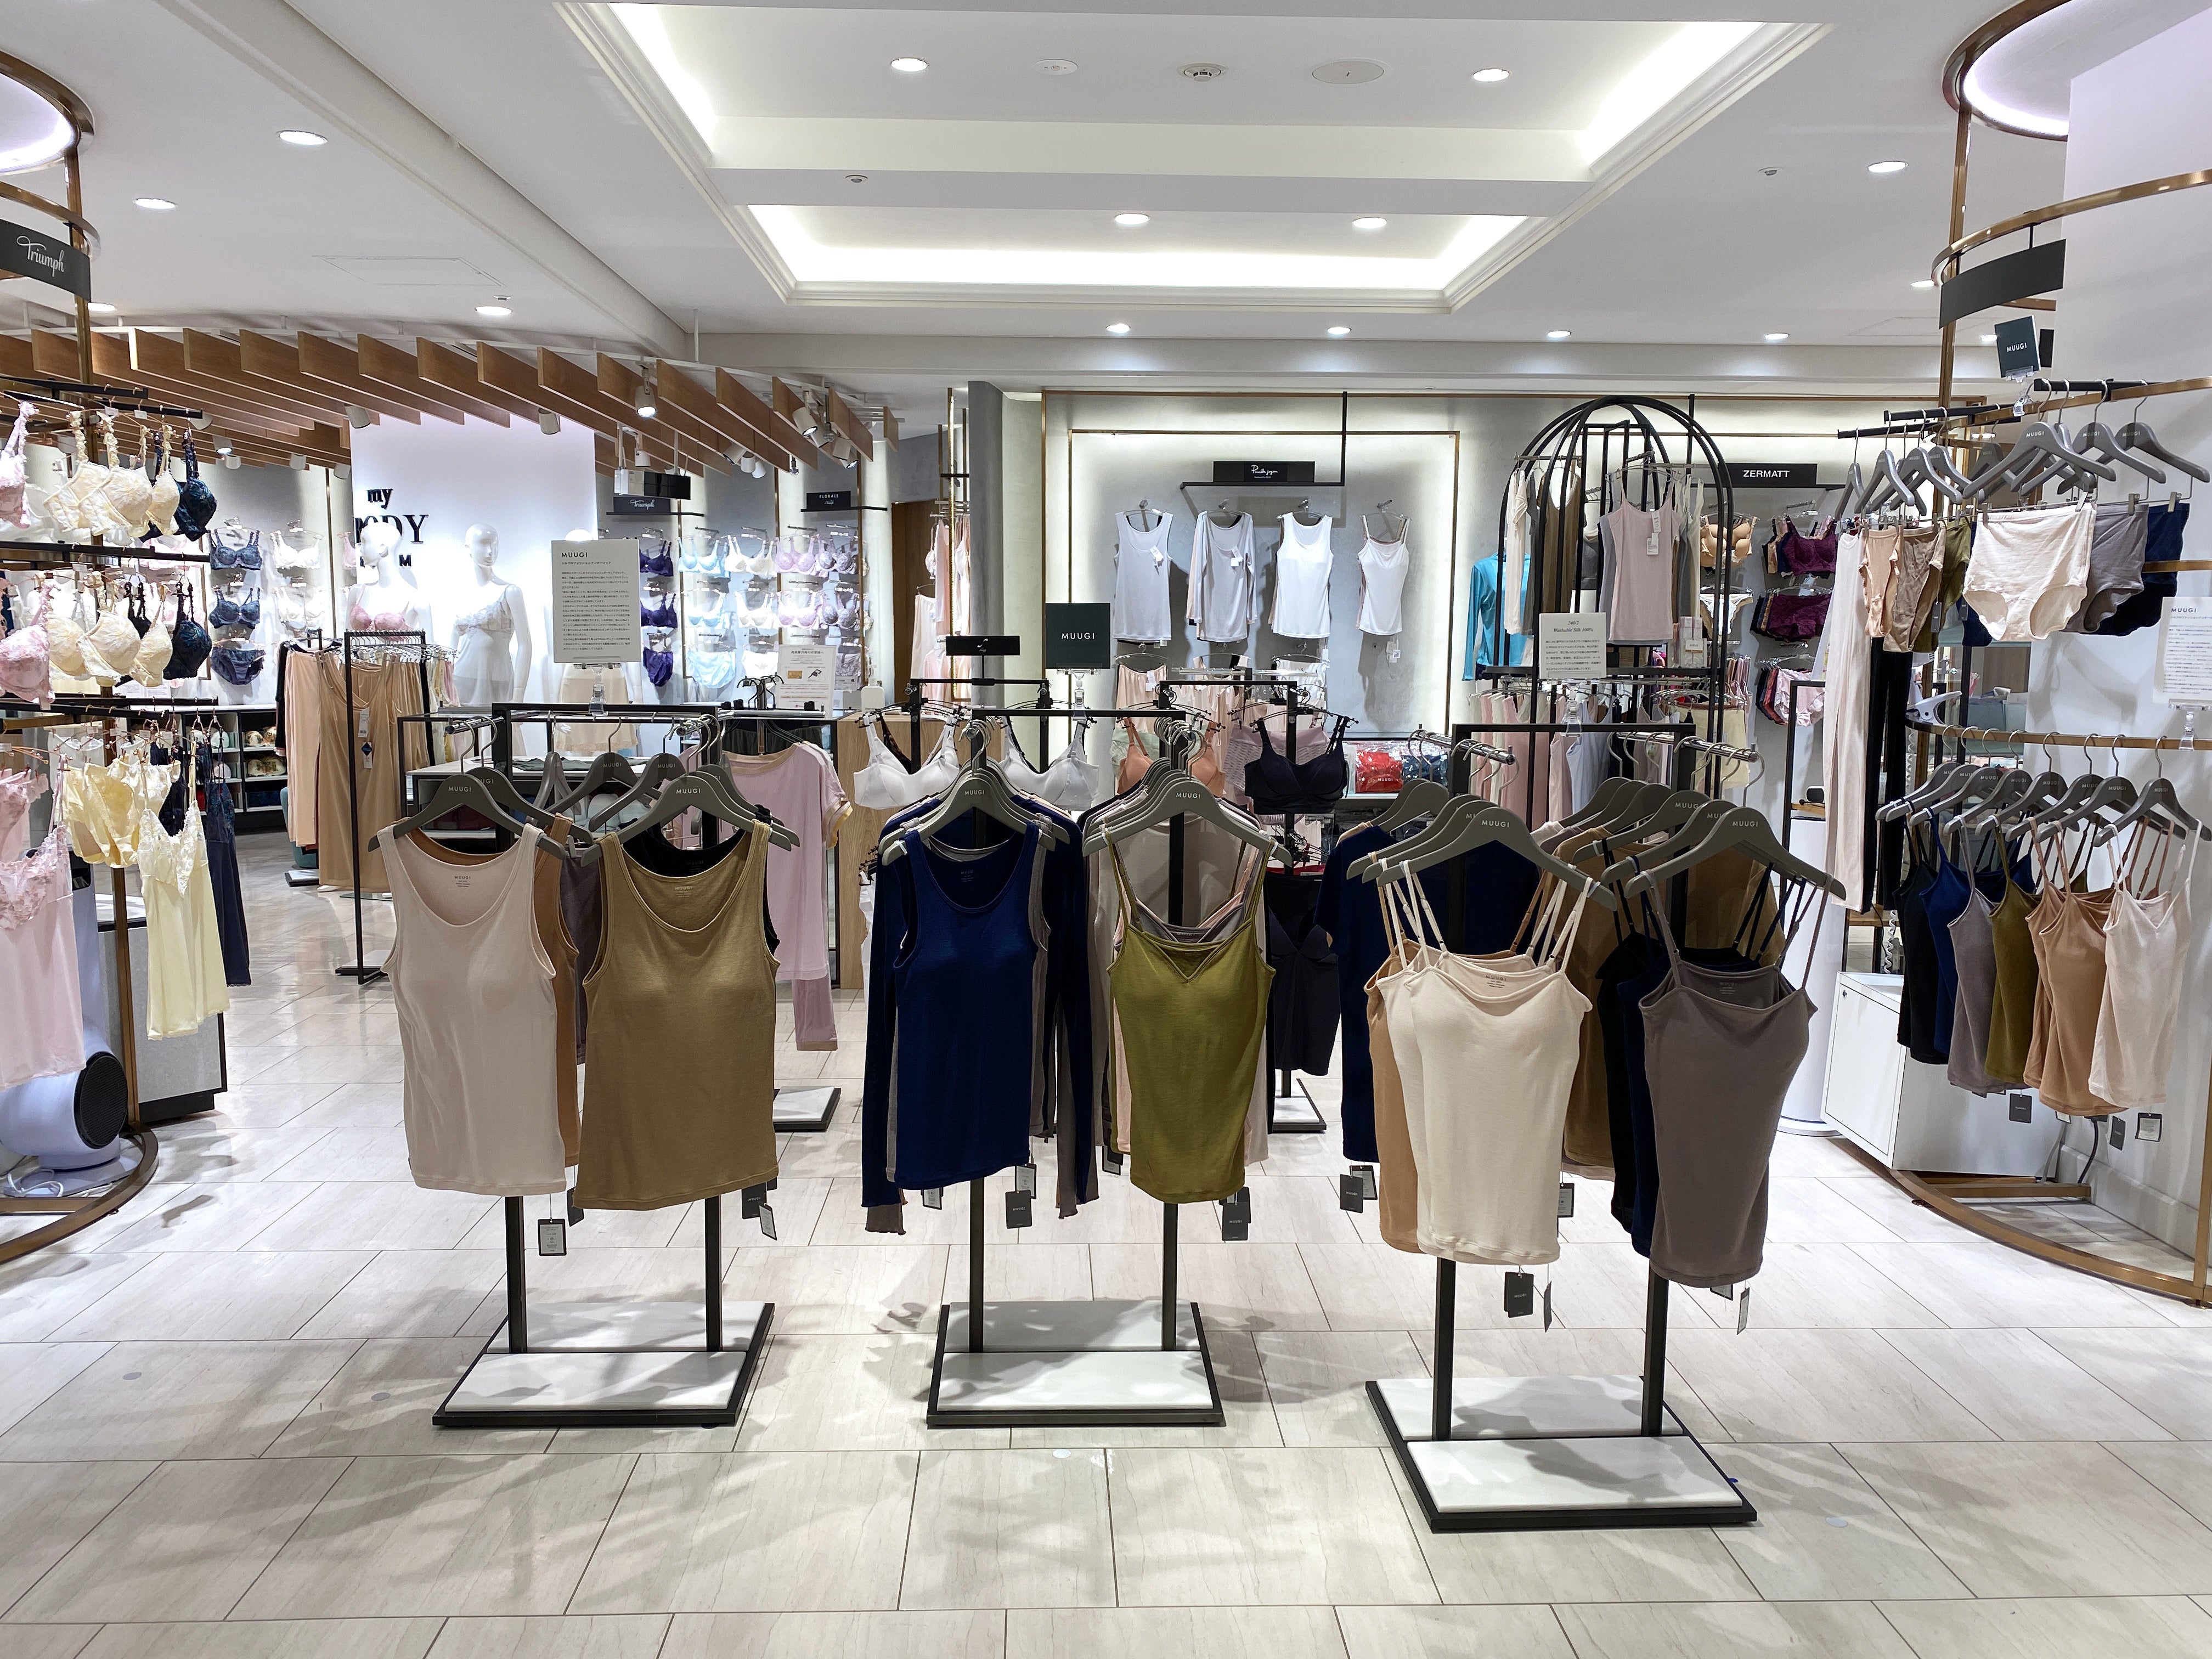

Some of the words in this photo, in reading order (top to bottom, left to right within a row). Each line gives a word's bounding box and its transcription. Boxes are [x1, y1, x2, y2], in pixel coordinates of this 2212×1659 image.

[16, 235, 65, 278] Triumph
[2007, 342, 2027, 352] MUUGI
[1743, 470, 1790, 478] ZERMATT
[366, 488, 393, 510] my
[630, 499, 655, 510] Triumph
